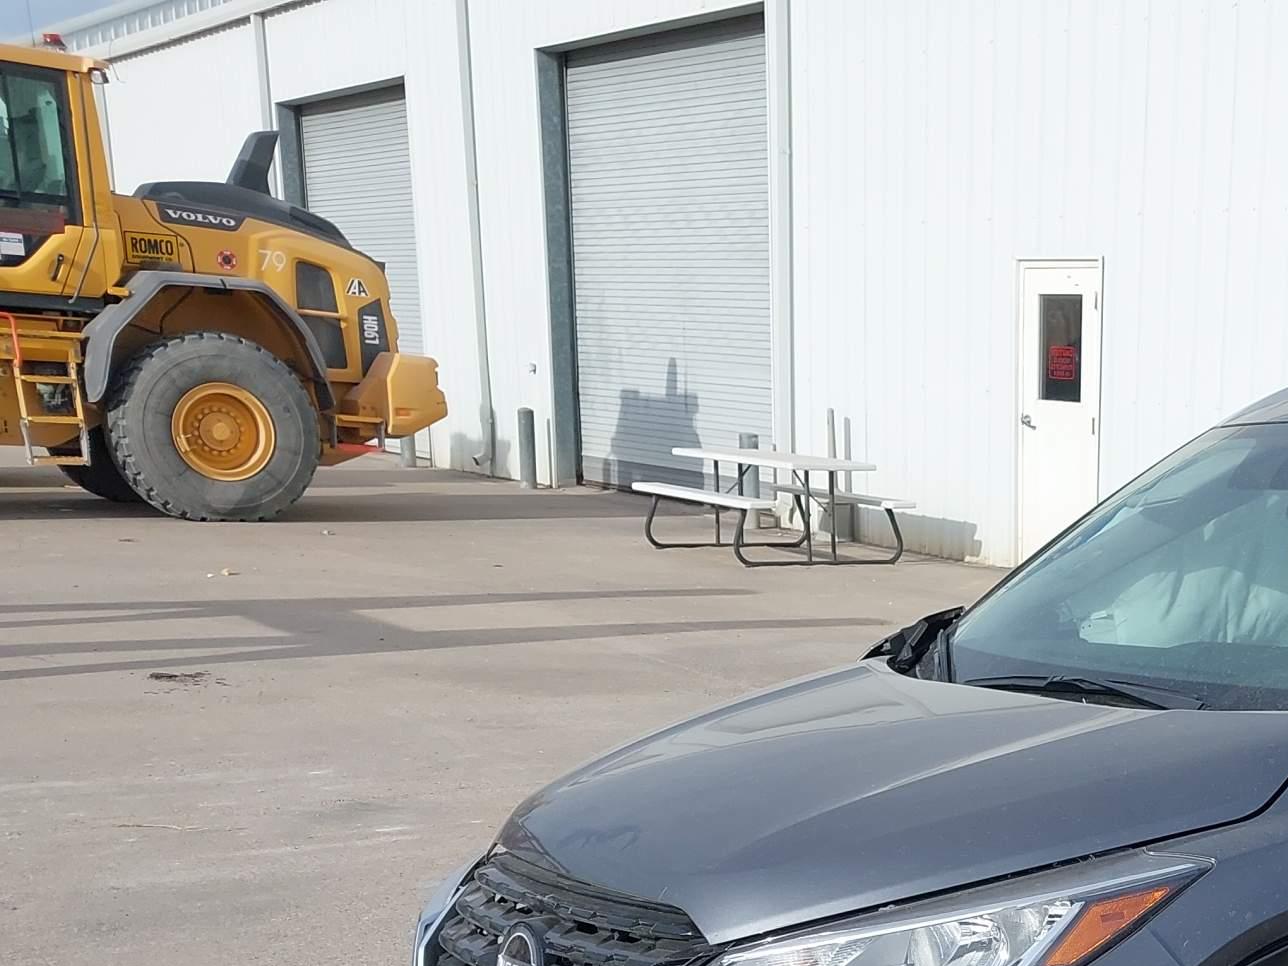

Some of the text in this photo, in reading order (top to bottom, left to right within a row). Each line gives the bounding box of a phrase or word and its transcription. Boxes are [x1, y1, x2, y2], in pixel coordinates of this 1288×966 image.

[166, 208, 236, 226] VOLVO
[130, 237, 174, 256] ROMCO
[258, 249, 287, 272] 79
[363, 315, 380, 345] L90H
